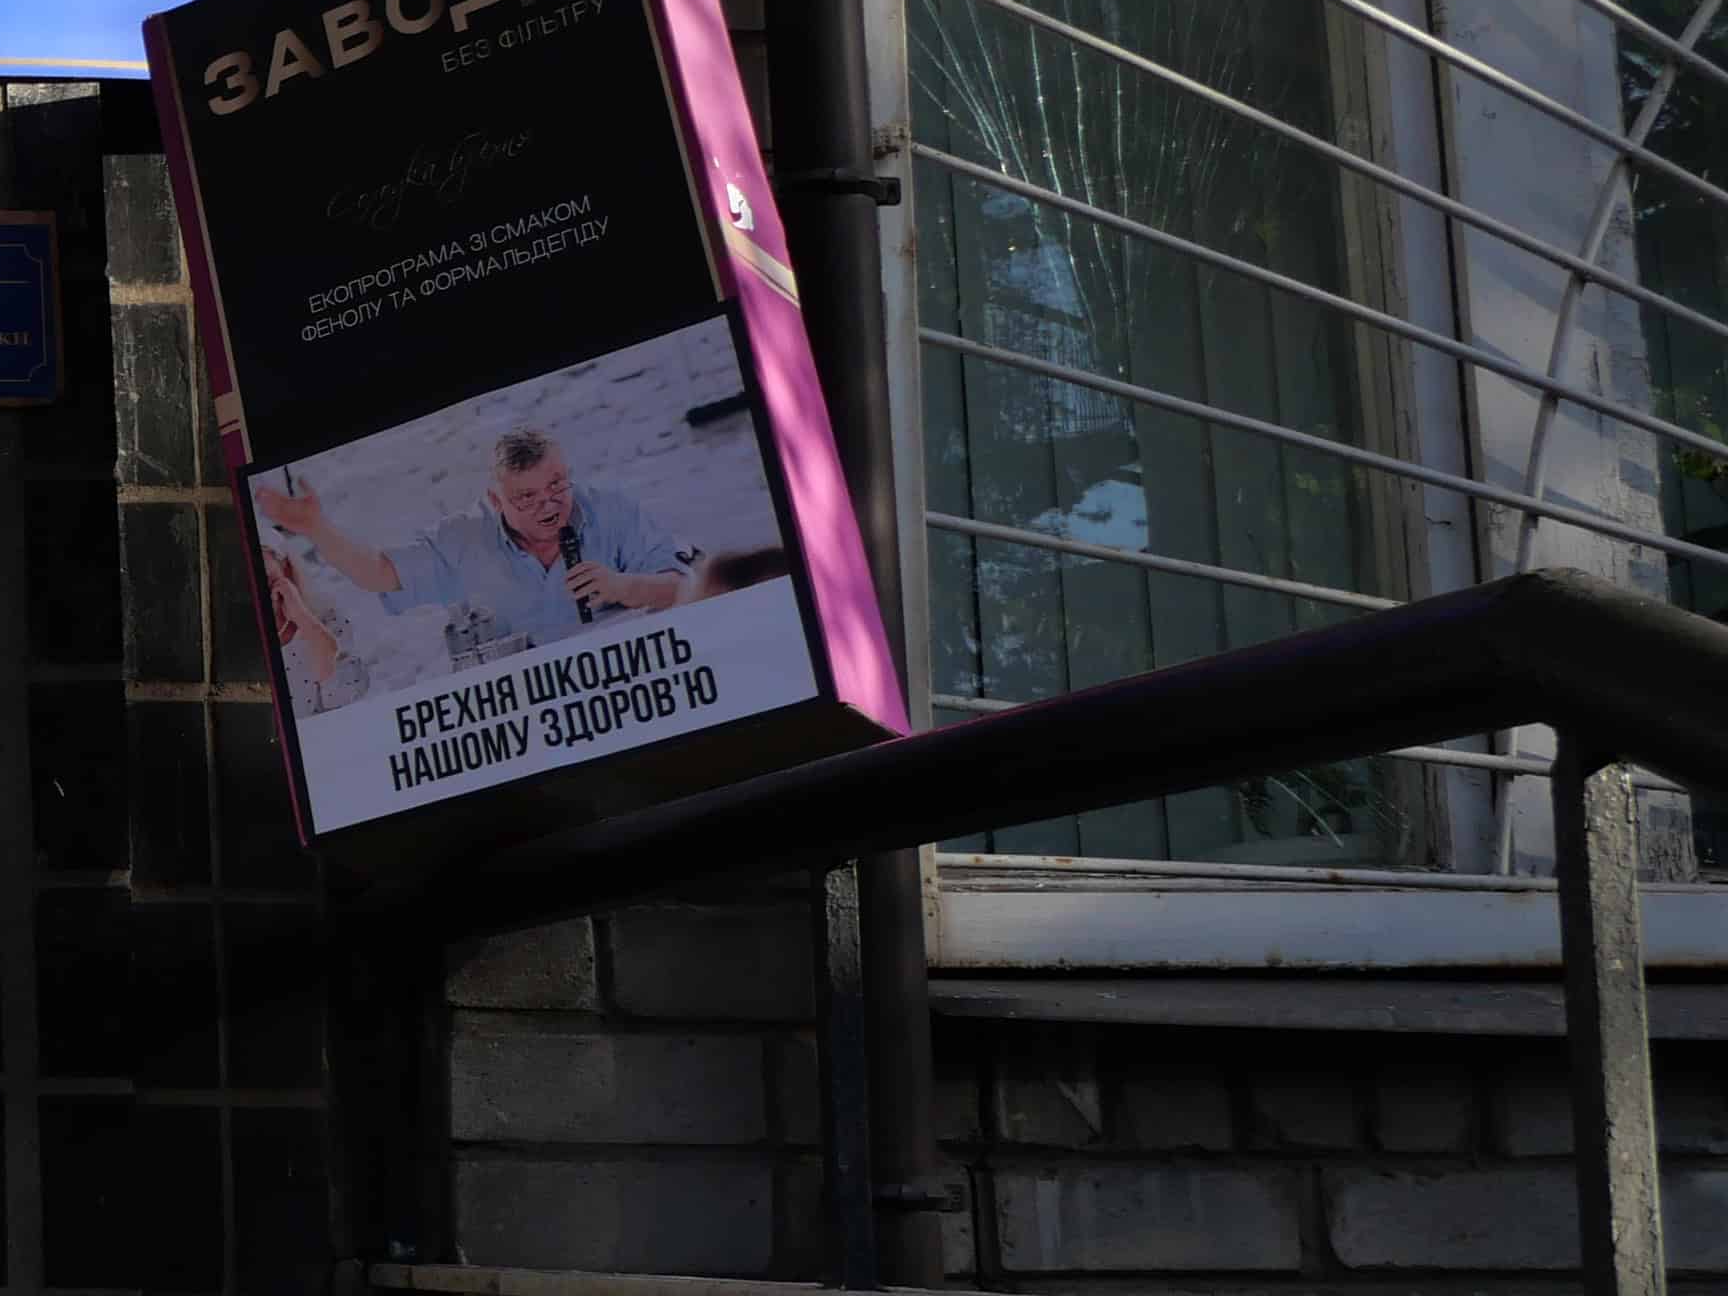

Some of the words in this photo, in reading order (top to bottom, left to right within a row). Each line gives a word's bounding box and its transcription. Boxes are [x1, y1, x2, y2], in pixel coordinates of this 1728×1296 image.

[440, 38, 492, 73] БЕЗ
[301, 297, 383, 342] ФЕНОЛУ
[390, 287, 417, 311] ТА
[419, 215, 609, 297] ФОРМАЛЬДЕГІДУ
[308, 239, 465, 314] ЕКОПРОГРАМА
[469, 232, 488, 252] ЗІ
[490, 194, 593, 245] СМАКОМ
[388, 714, 529, 792] НАШОМУ
[539, 664, 719, 748] ЗДОРОВ'Ю
[395, 674, 518, 744] БРЕХНЯ
[523, 627, 693, 707] ШКОДИТЬ
